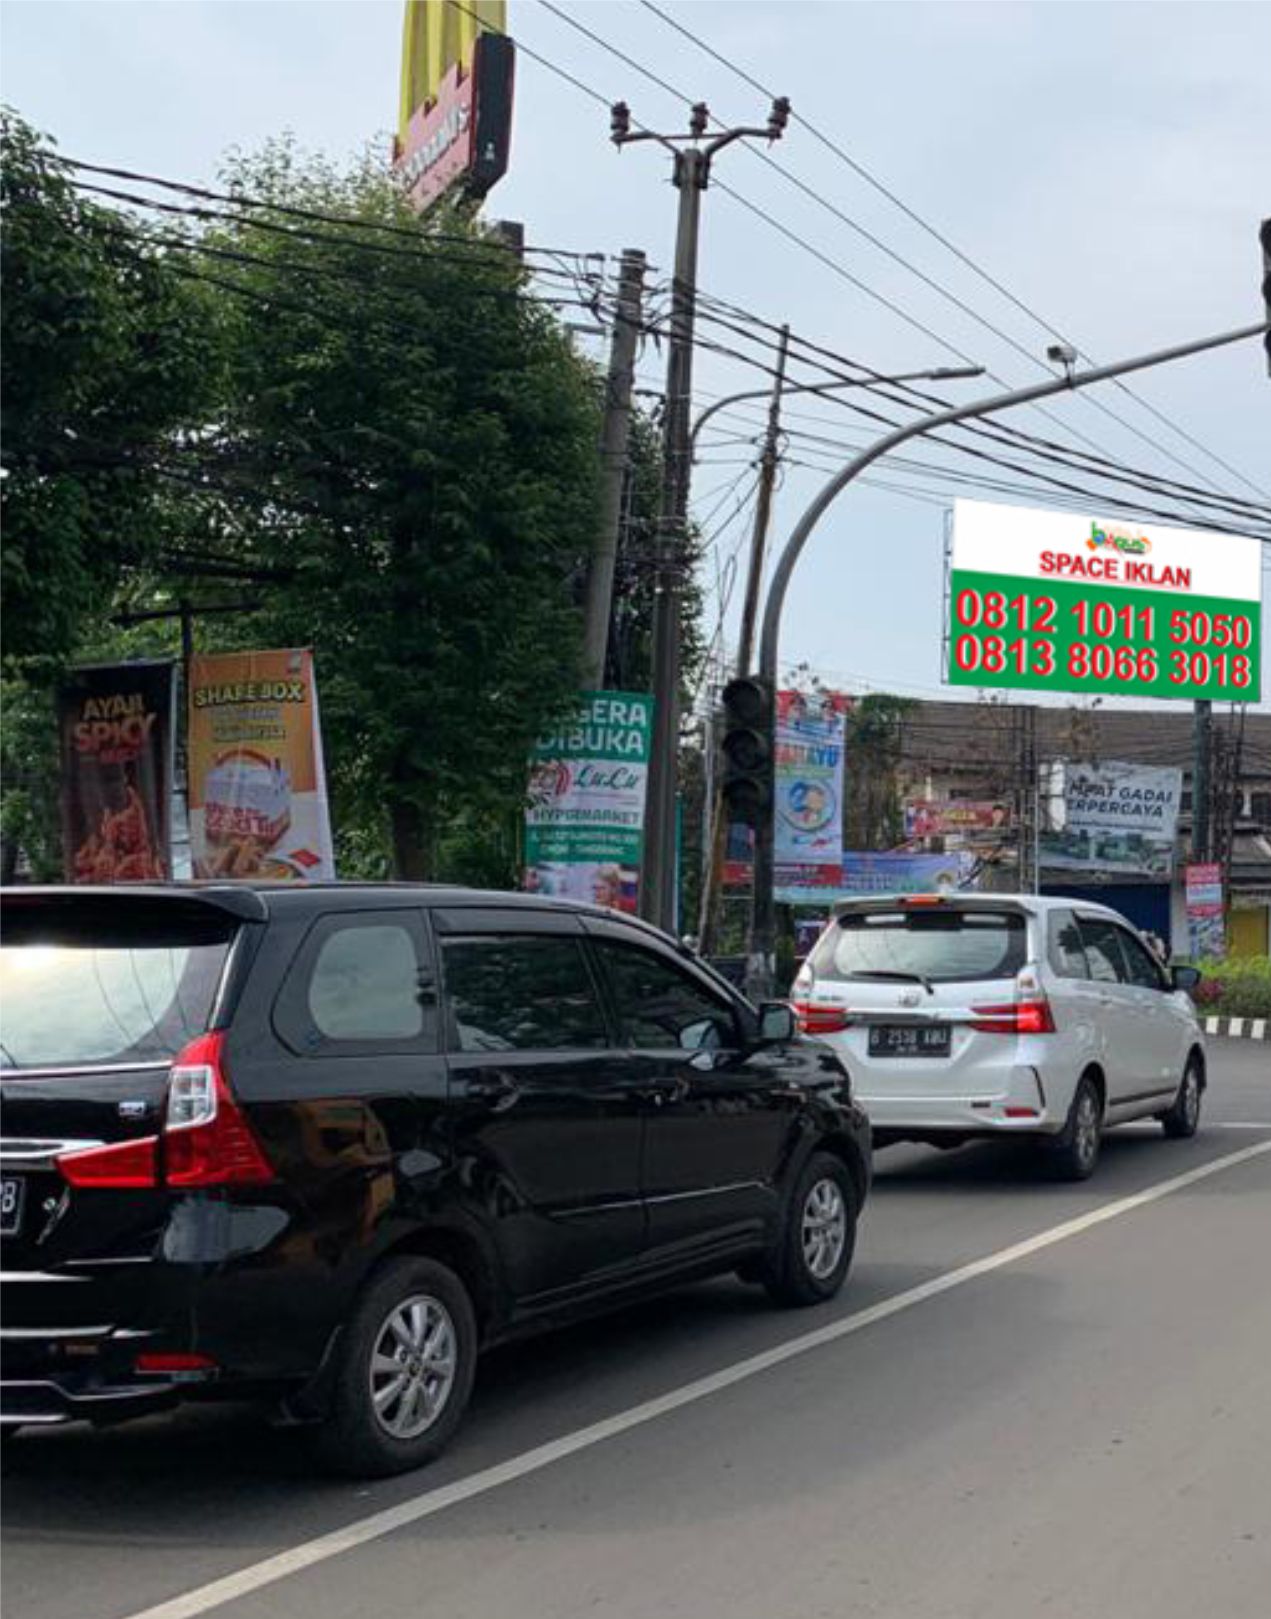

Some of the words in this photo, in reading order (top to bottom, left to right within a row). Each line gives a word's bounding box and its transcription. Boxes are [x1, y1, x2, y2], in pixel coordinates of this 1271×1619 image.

[1040, 551, 1117, 580] SPACE
[1125, 561, 1191, 588] IKLAN
[956, 588, 1057, 633] 0812
[1071, 599, 1155, 640] 1011
[1169, 610, 1251, 649] 5050
[955, 634, 1056, 676] 0813
[1068, 642, 1158, 682] 8066
[1169, 650, 1251, 688] 3018
[74, 712, 157, 752] SPICY
[1066, 798, 1163, 819] ERPERCAYA
[1119, 786, 1173, 804] GADAI
